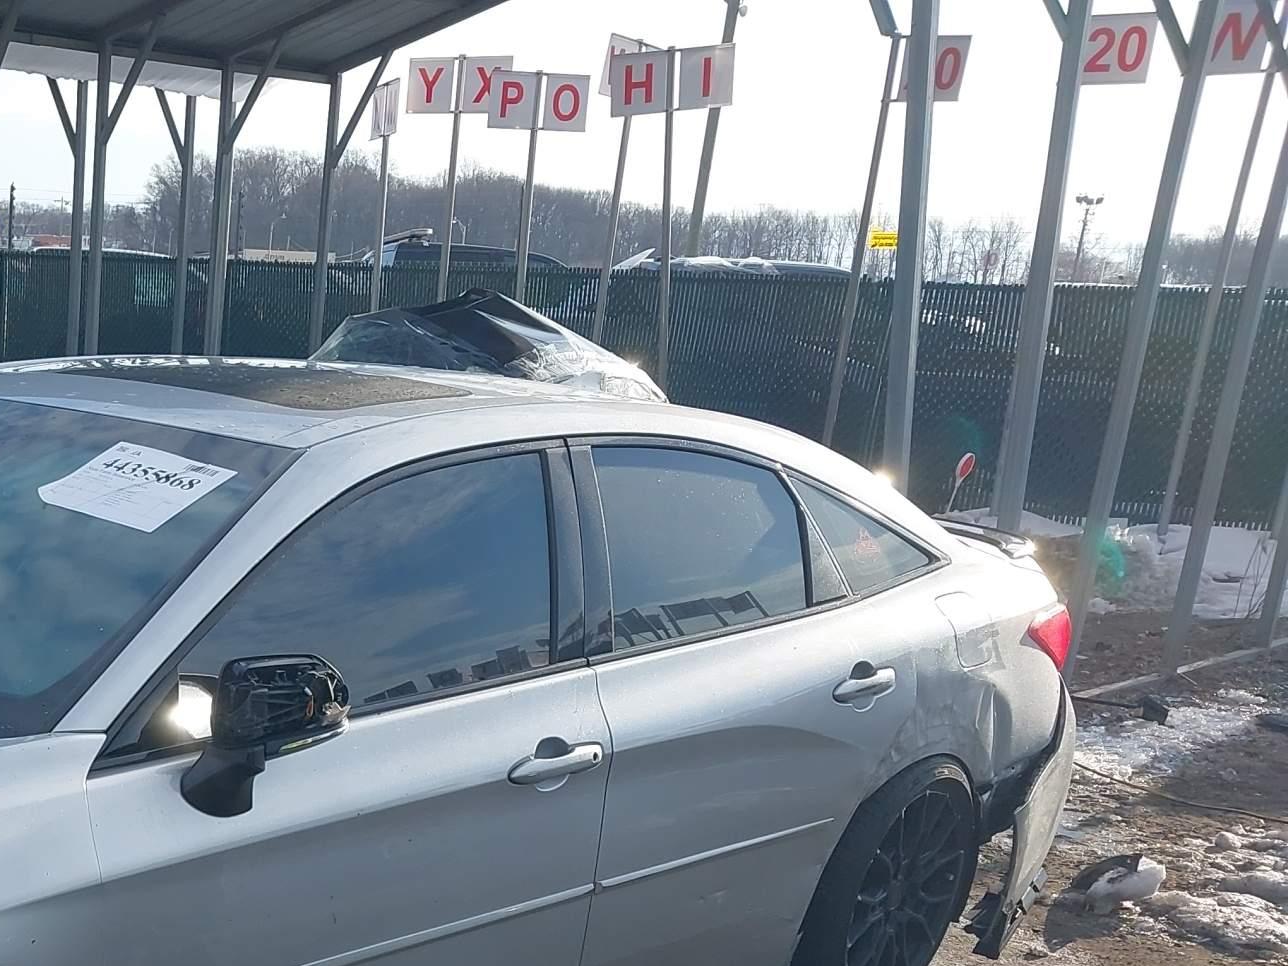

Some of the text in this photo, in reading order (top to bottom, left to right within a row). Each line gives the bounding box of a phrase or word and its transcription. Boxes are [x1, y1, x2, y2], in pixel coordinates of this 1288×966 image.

[1083, 26, 1147, 72] 20
[418, 66, 502, 104] Y X
[499, 80, 580, 122] P O
[624, 63, 653, 105] H
[702, 57, 712, 97] I
[102, 458, 202, 491] 44355868
